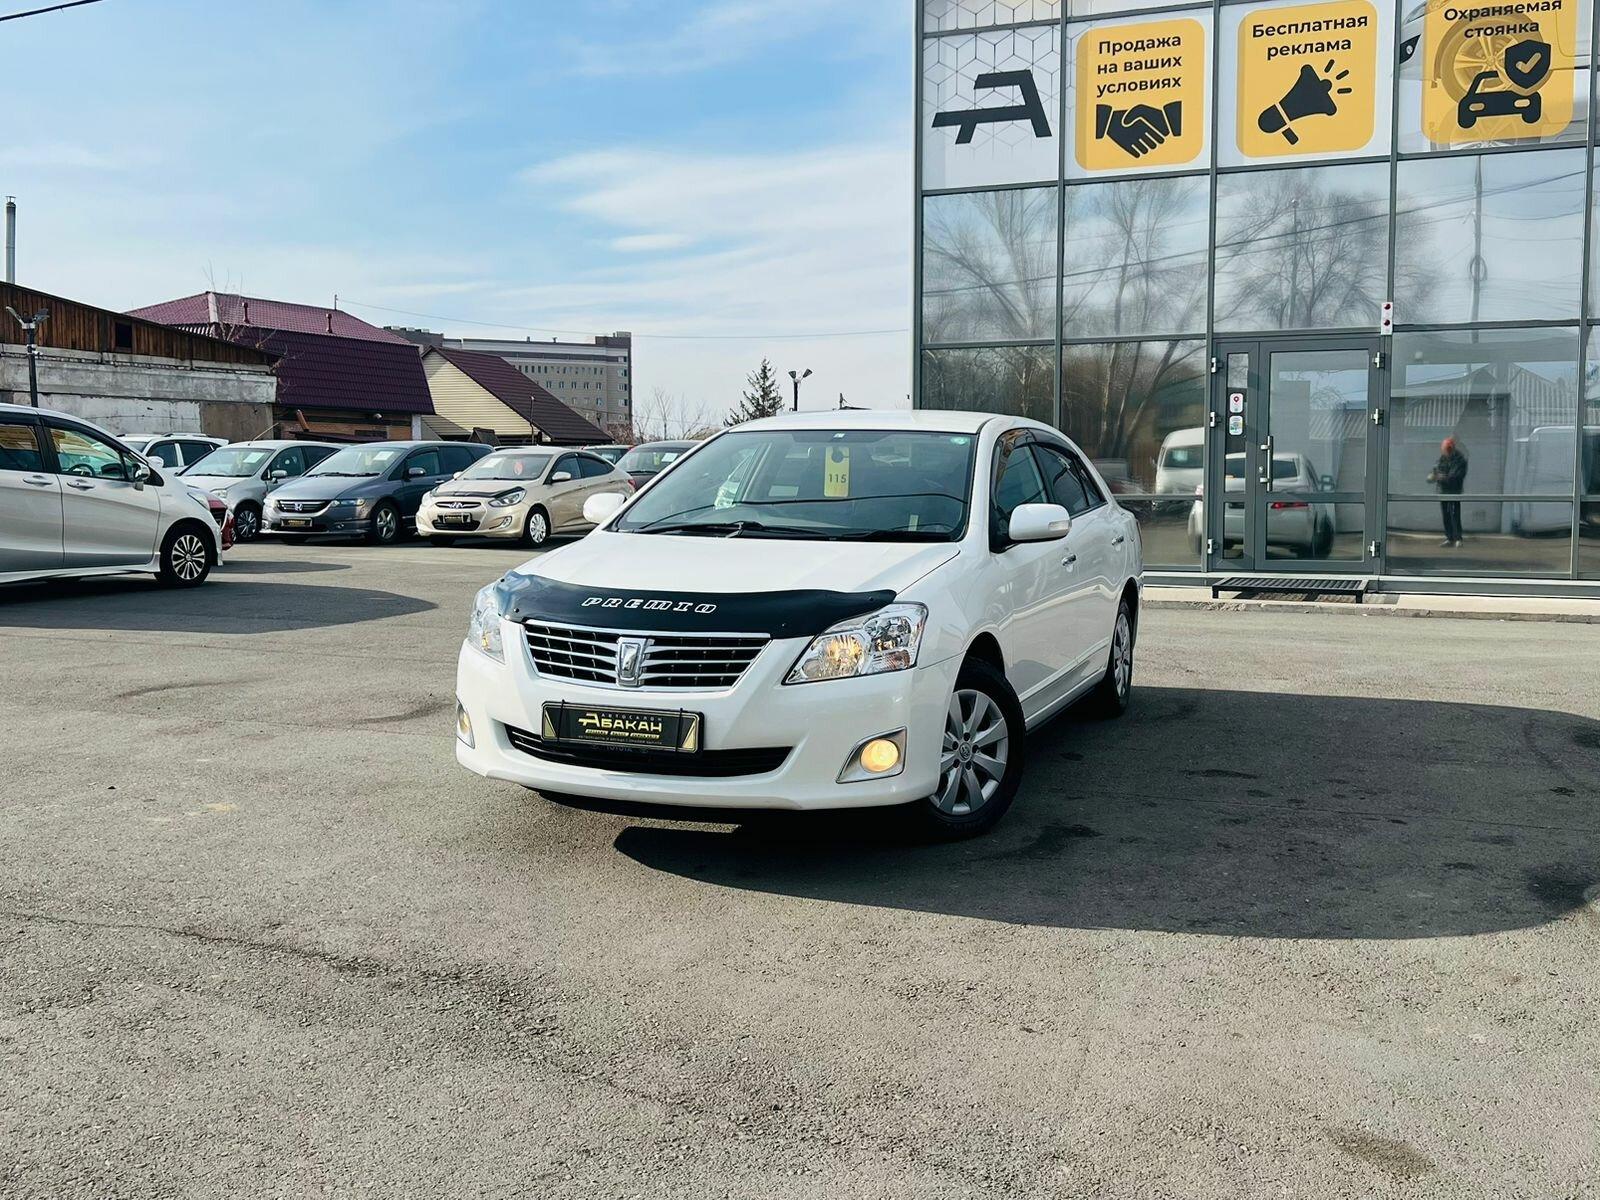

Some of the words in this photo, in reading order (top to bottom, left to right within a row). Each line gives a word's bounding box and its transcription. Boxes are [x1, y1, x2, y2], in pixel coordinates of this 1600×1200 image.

[1444, 0, 1562, 21] Охраняемая
[1252, 16, 1368, 38] Бесплатная
[1464, 22, 1540, 38] стоянка
[1098, 36, 1182, 56] Продажа
[1267, 39, 1352, 60] реклама
[1097, 63, 1118, 75] на
[1123, 56, 1182, 72] ваших
[1096, 76, 1182, 98] условиях
[828, 473, 847, 484] 115
[581, 597, 717, 614] PREMIO
[578, 712, 663, 733] АБАКАН
